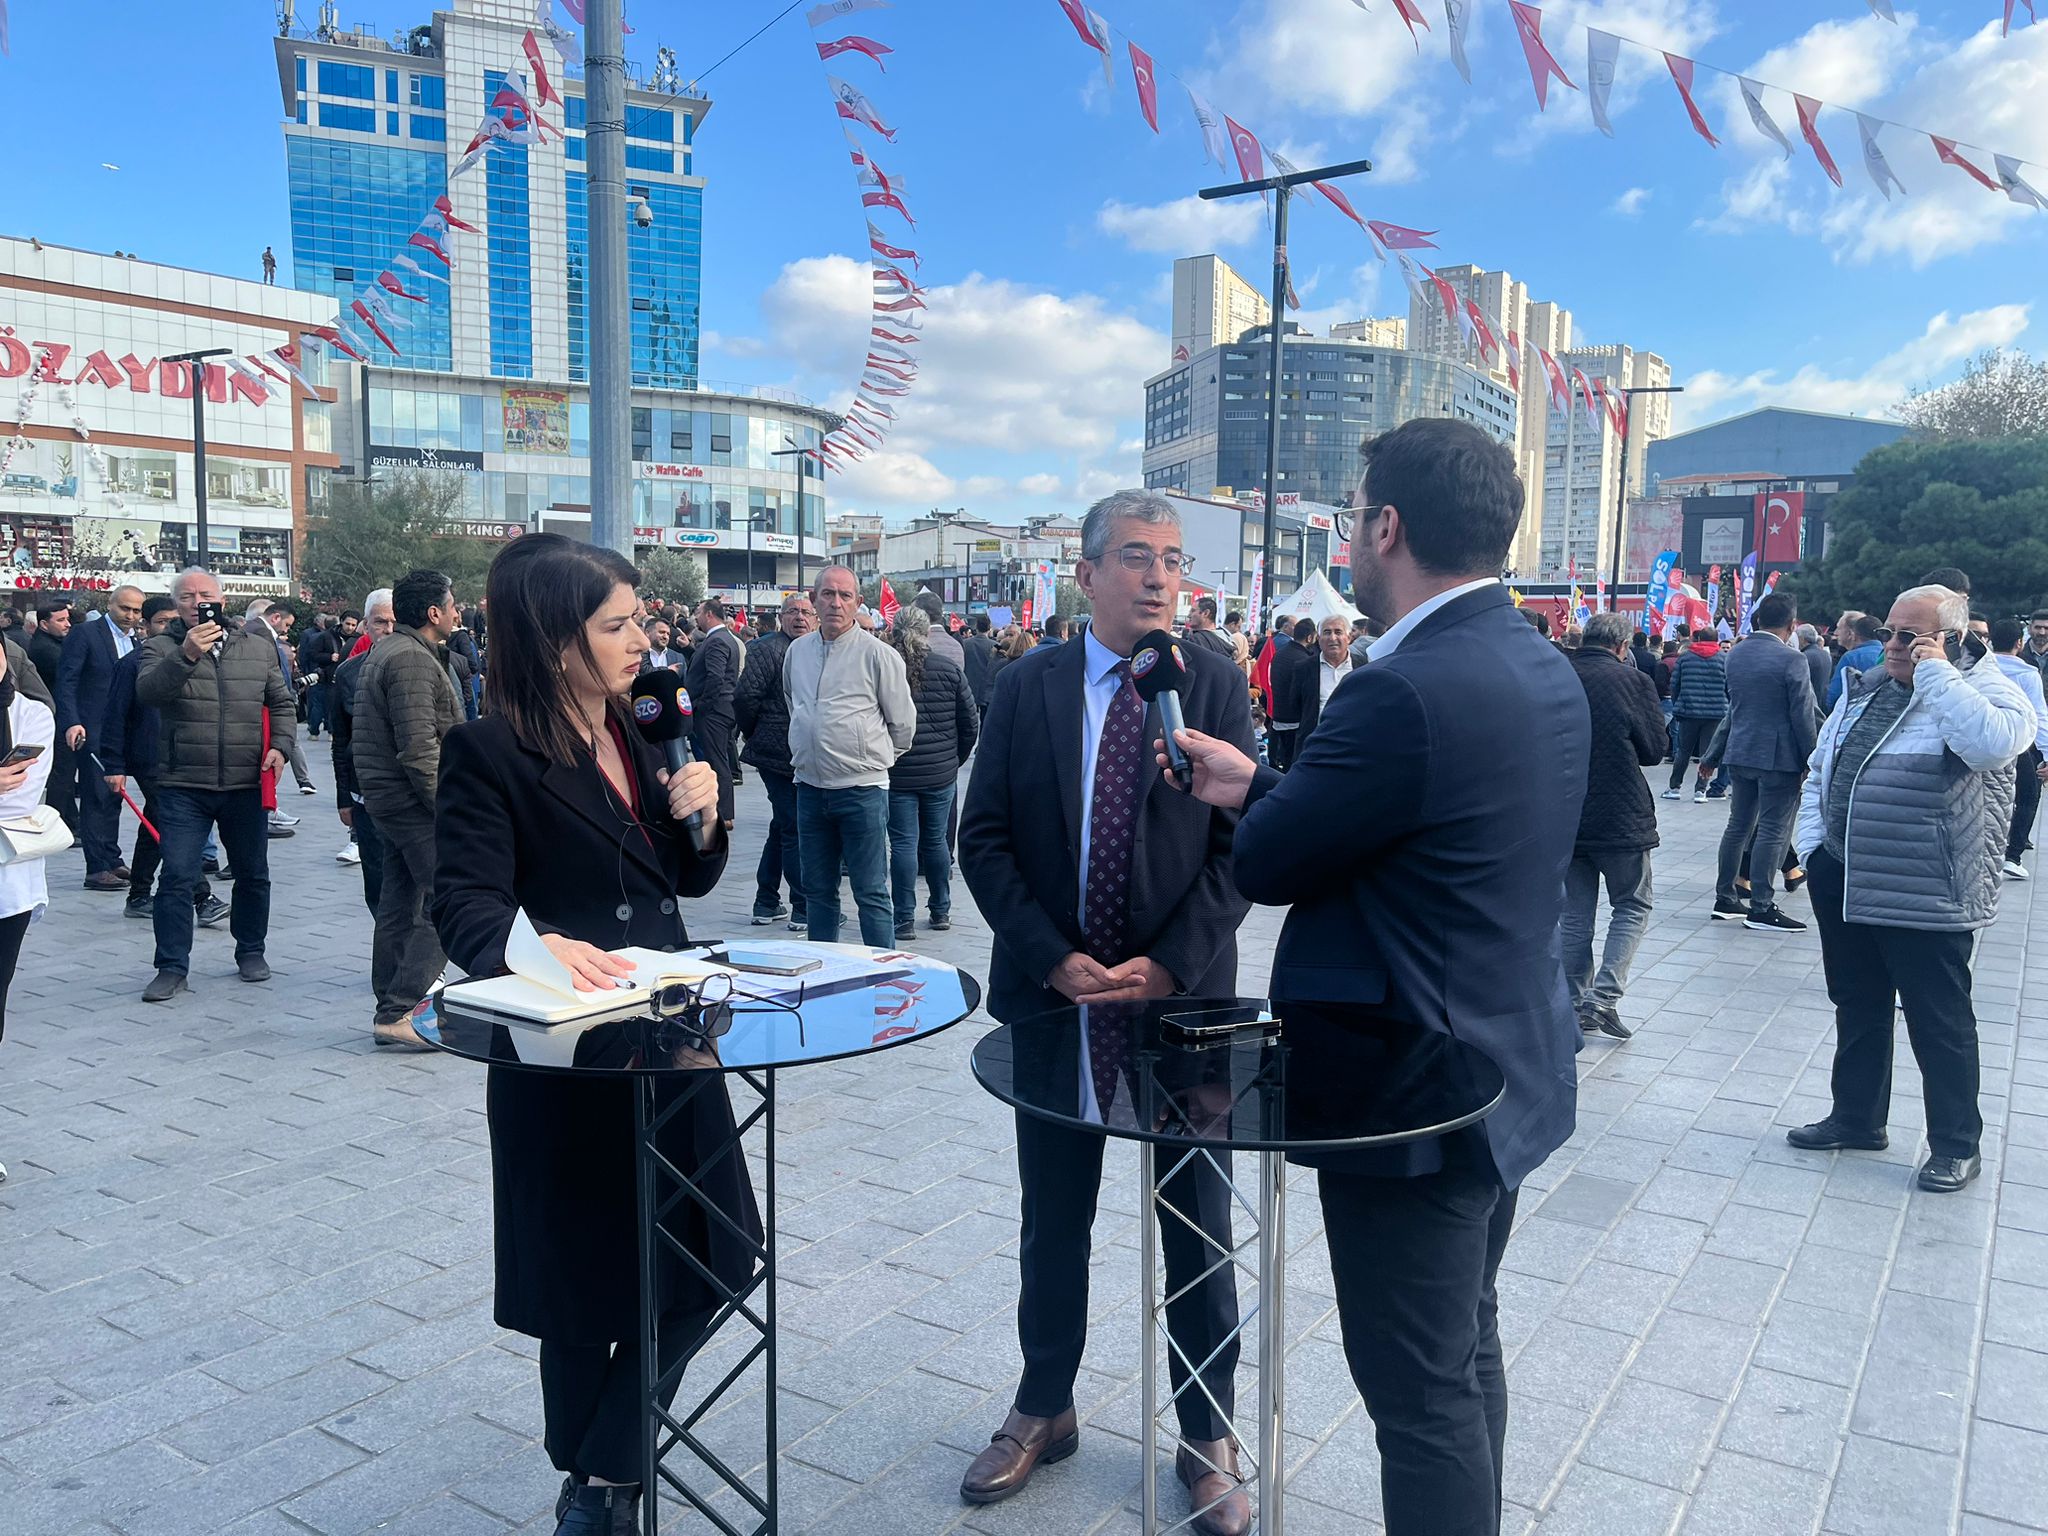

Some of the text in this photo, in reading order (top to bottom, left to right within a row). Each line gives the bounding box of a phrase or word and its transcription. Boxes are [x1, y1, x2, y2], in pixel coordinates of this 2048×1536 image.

[373, 456, 474, 470] GÜZELLİK SALONLARI
[655, 464, 703, 477] Waffle Caffe
[1253, 494, 1298, 507] EVARK
[466, 524, 503, 536] KING
[222, 582, 287, 594] UYUMCULUK
[1741, 566, 1755, 603] SOL
[1133, 652, 1155, 674] SZC
[634, 701, 658, 718] SZC
